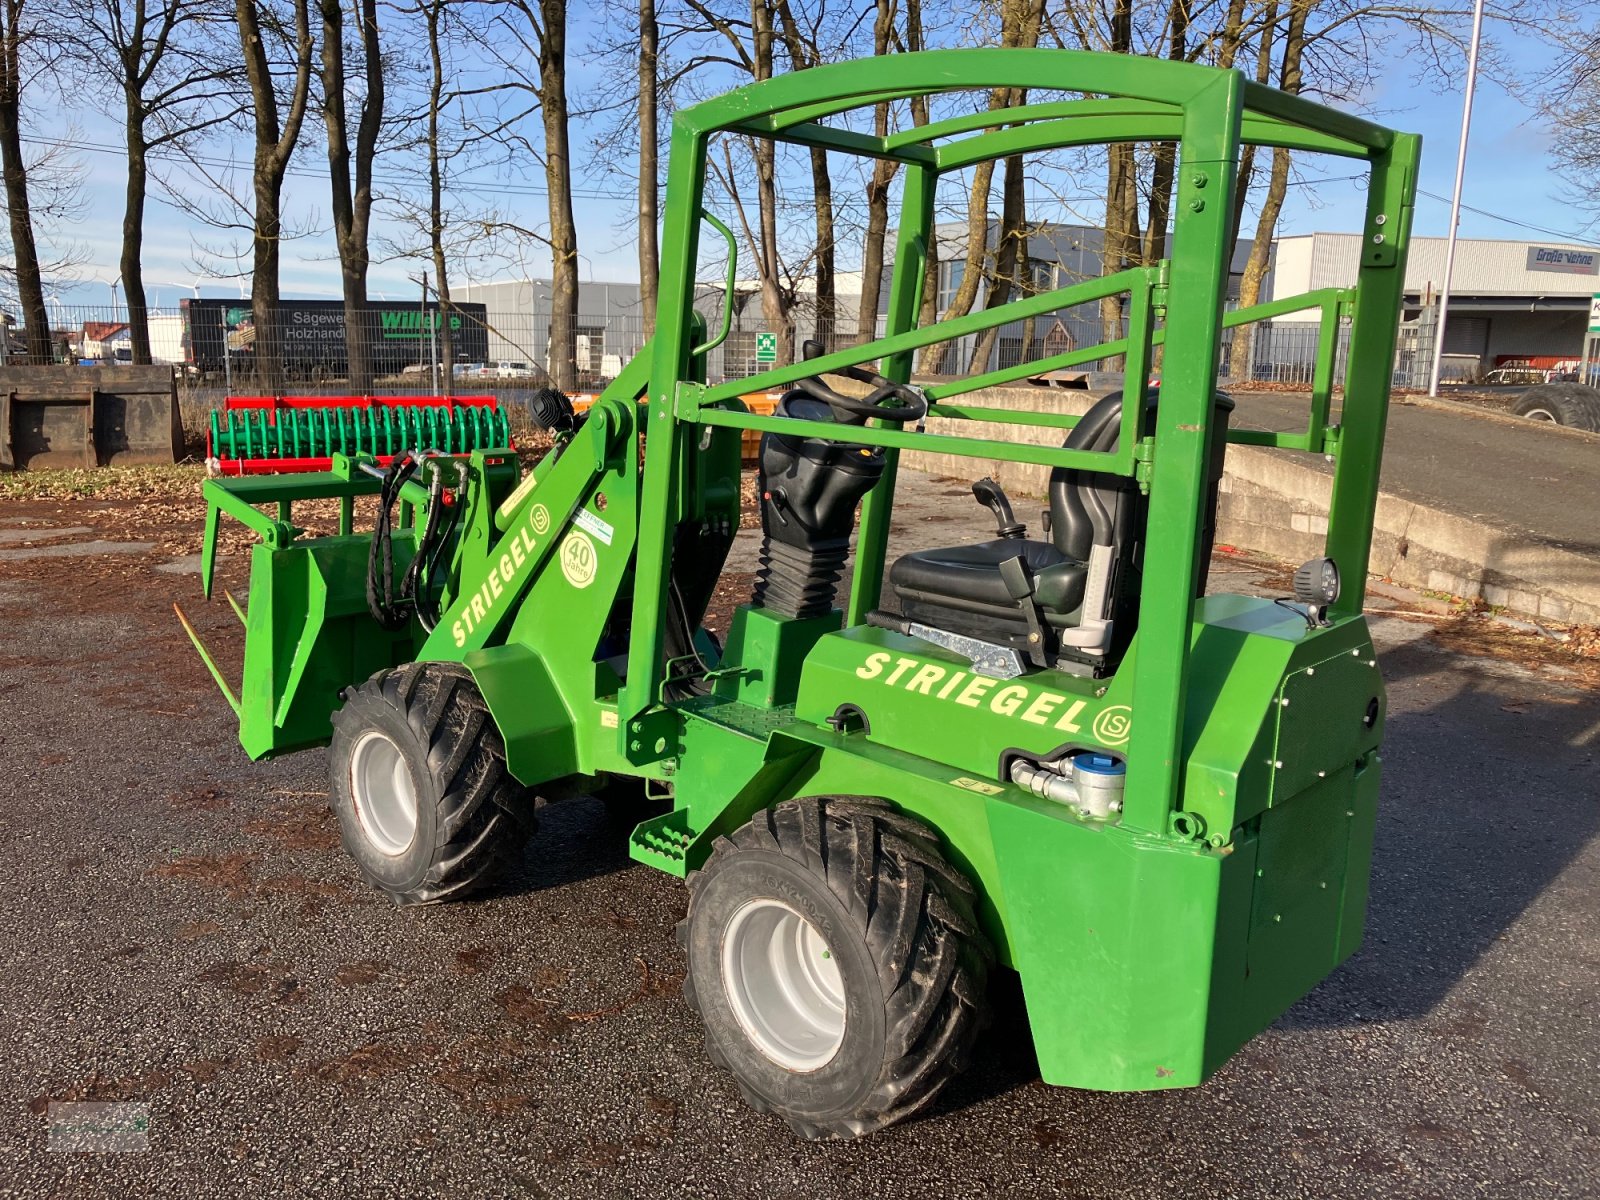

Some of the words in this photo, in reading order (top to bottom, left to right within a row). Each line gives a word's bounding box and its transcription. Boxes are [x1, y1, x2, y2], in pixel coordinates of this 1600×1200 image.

[565, 559, 589, 578] Jahre
[568, 540, 590, 567] 40
[452, 526, 537, 648] STRIEGEL
[855, 652, 1088, 734] STRIEGEL
